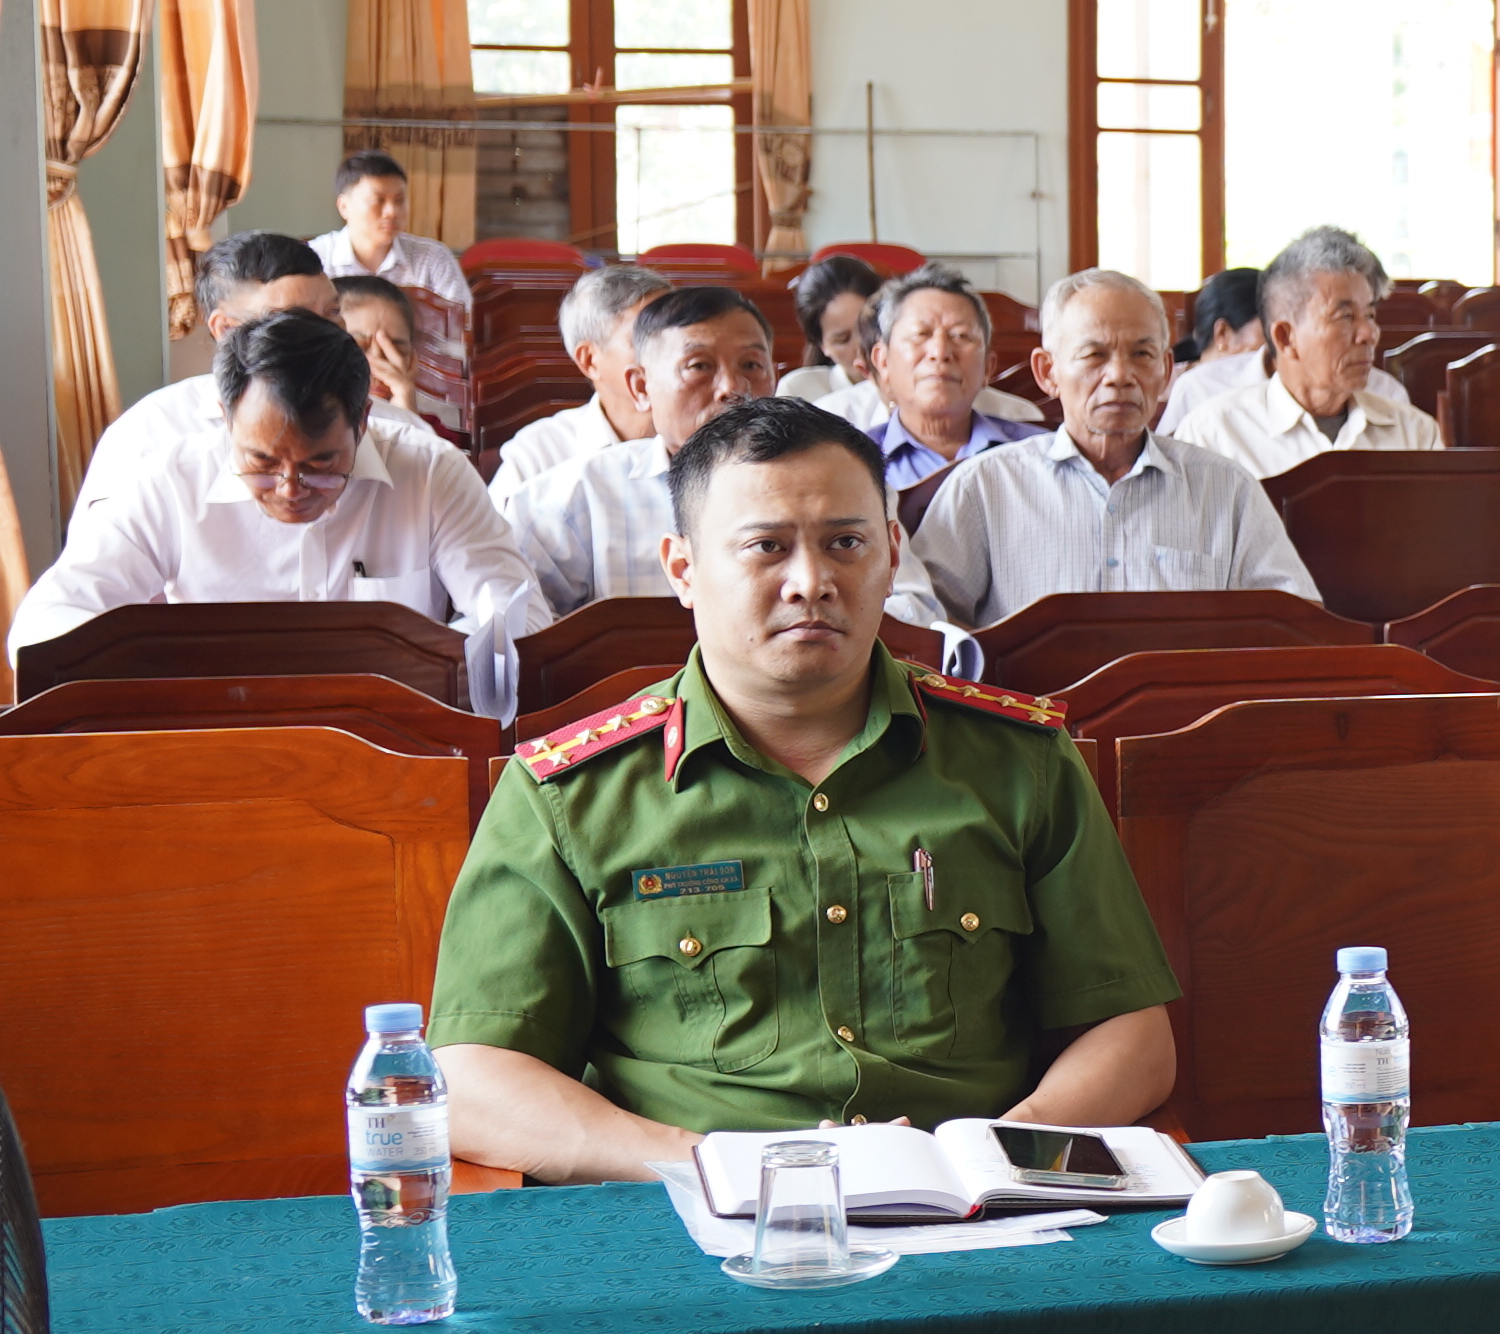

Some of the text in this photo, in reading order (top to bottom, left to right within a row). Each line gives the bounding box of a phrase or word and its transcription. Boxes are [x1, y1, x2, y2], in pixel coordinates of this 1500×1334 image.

[365, 1117, 385, 1128] TH
[366, 1130, 403, 1146] true
[368, 1147, 403, 1157] WATER
